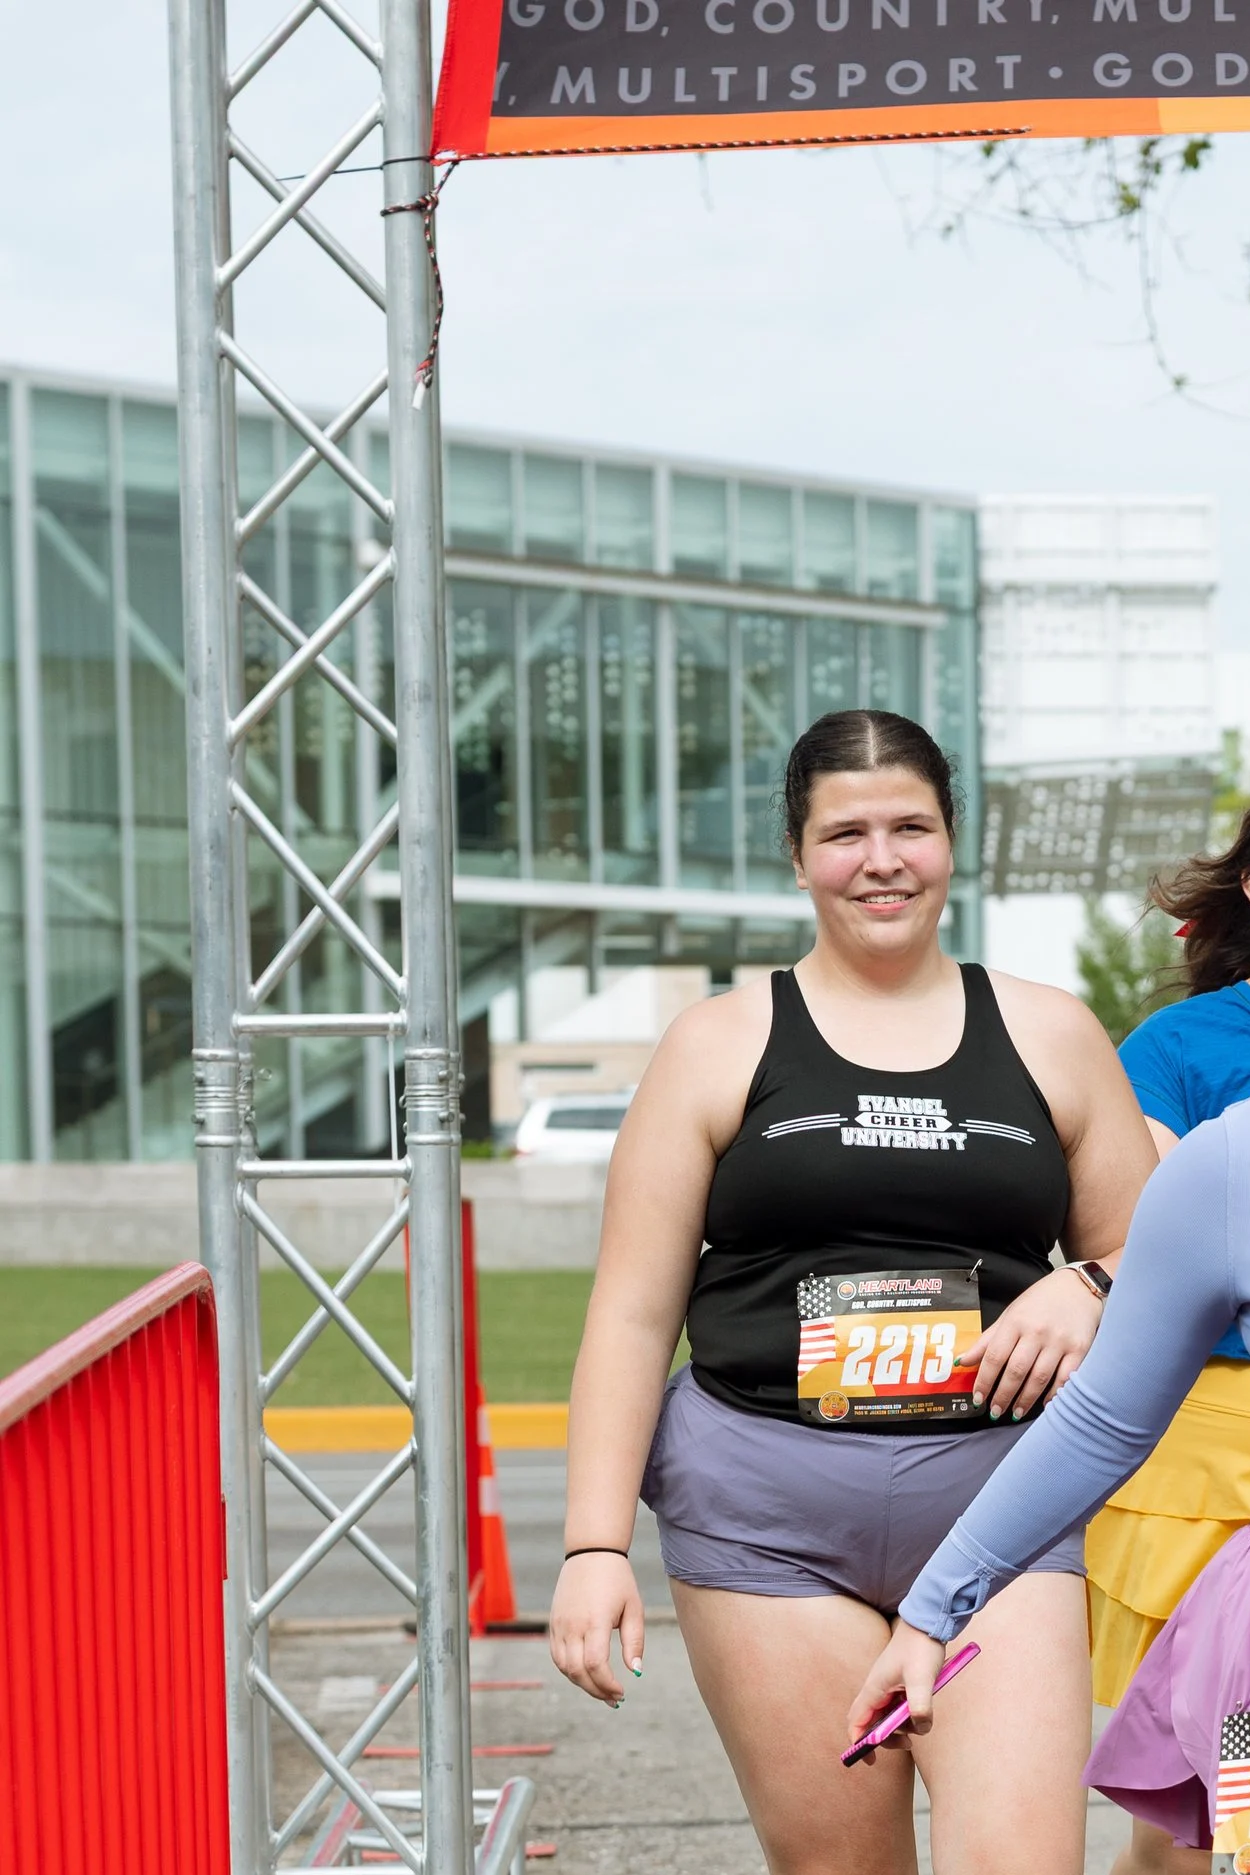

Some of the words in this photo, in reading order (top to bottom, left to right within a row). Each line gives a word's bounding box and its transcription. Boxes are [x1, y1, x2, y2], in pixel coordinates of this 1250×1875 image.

[507, 0, 670, 37] GOD,
[704, 0, 1060, 34] COUNTRY,
[549, 54, 1022, 104] MULTISPORT
[857, 1094, 948, 1117] EVANGEL
[870, 1114, 938, 1129] CHEER
[840, 1127, 968, 1151] UNIVERSITY
[858, 1278, 943, 1294] HEARTLAND
[840, 1322, 957, 1387] 2213
